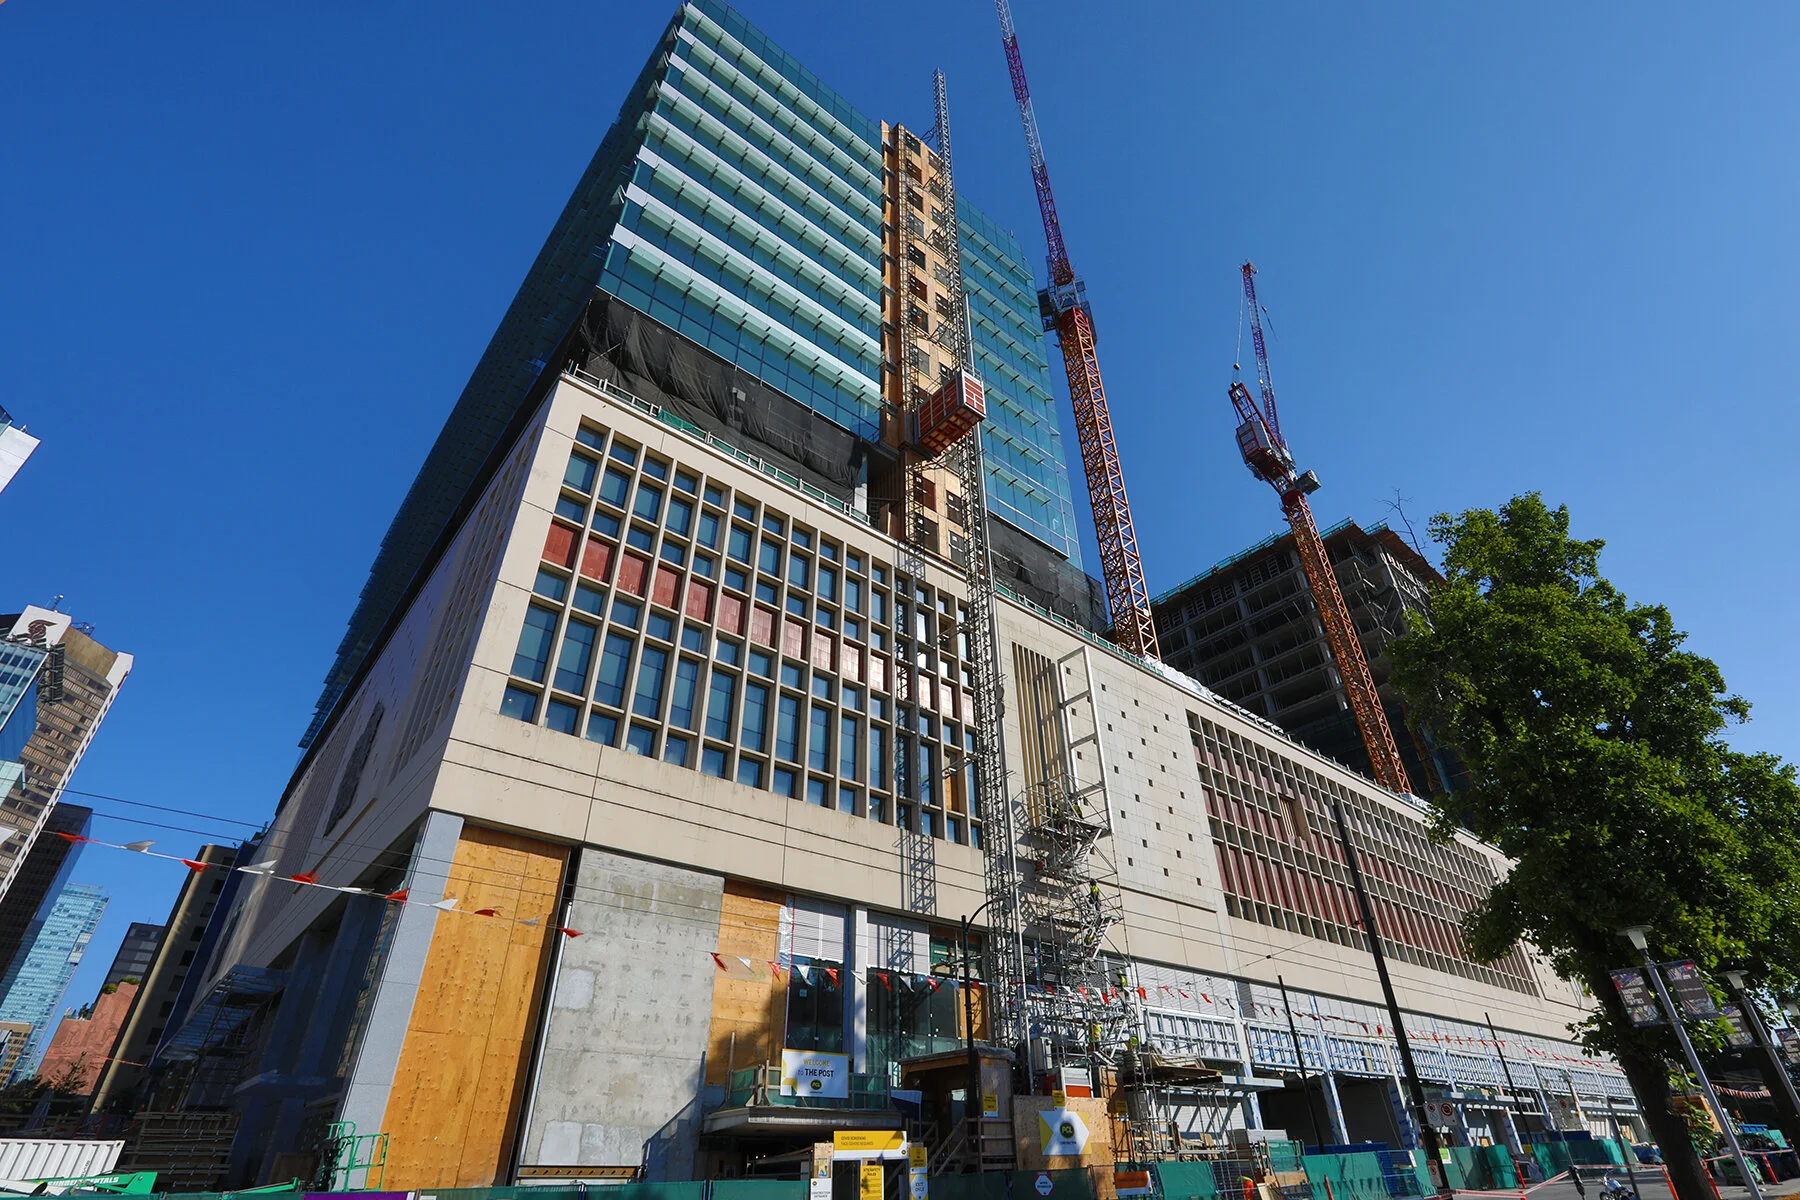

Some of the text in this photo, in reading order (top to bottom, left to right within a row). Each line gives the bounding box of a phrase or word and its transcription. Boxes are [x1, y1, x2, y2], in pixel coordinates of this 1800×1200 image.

[805, 1068, 817, 1076] THE
[819, 1069, 834, 1077] POST
[1062, 1126, 1072, 1134] PCL
